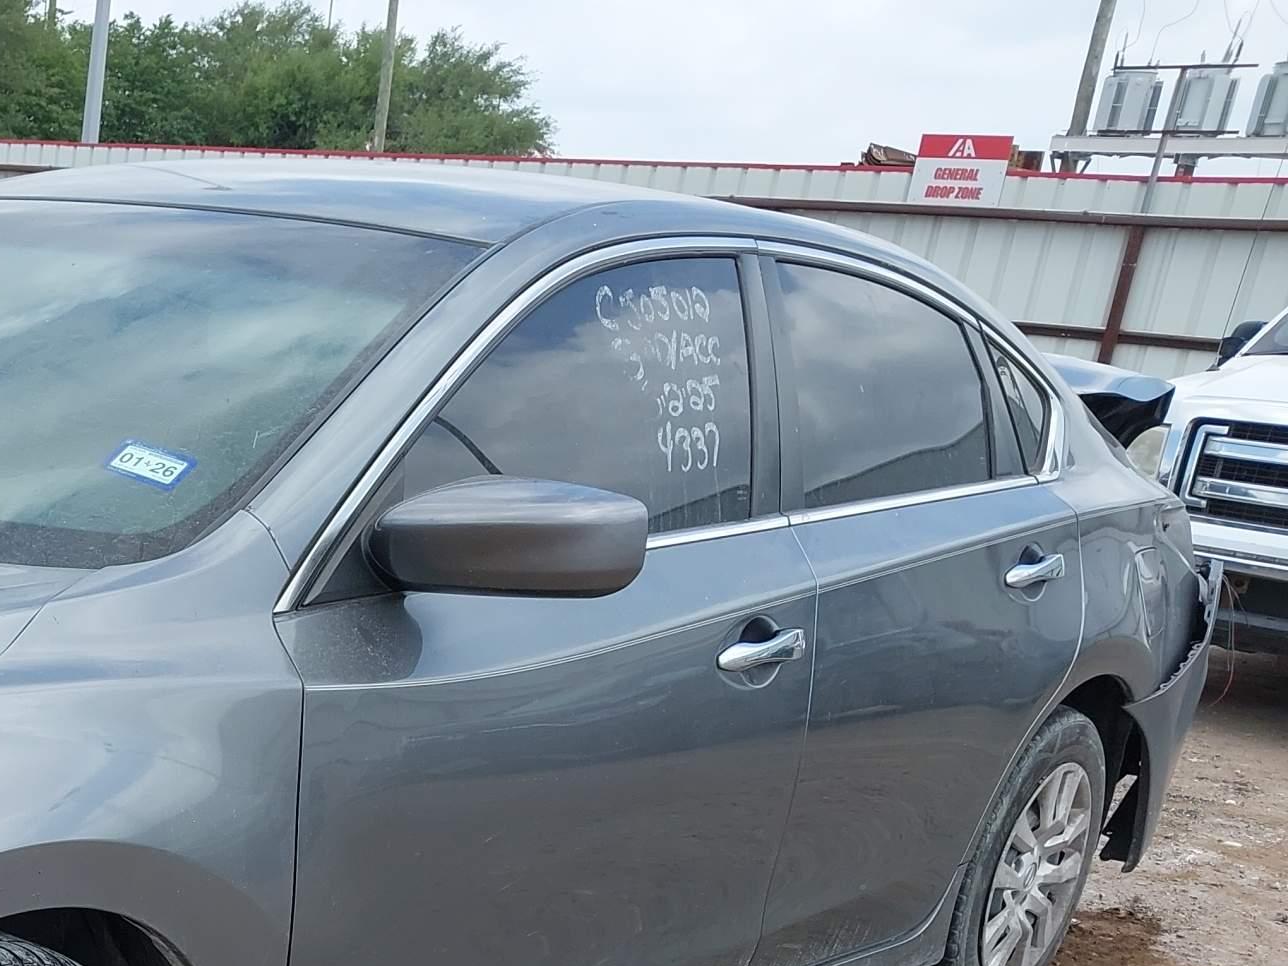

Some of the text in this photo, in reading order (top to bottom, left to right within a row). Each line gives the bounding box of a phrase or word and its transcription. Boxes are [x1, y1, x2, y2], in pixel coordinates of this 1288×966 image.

[934, 167, 980, 182] GENERAL
[924, 185, 983, 200] DROP ZONE
[657, 420, 720, 473] 4337
